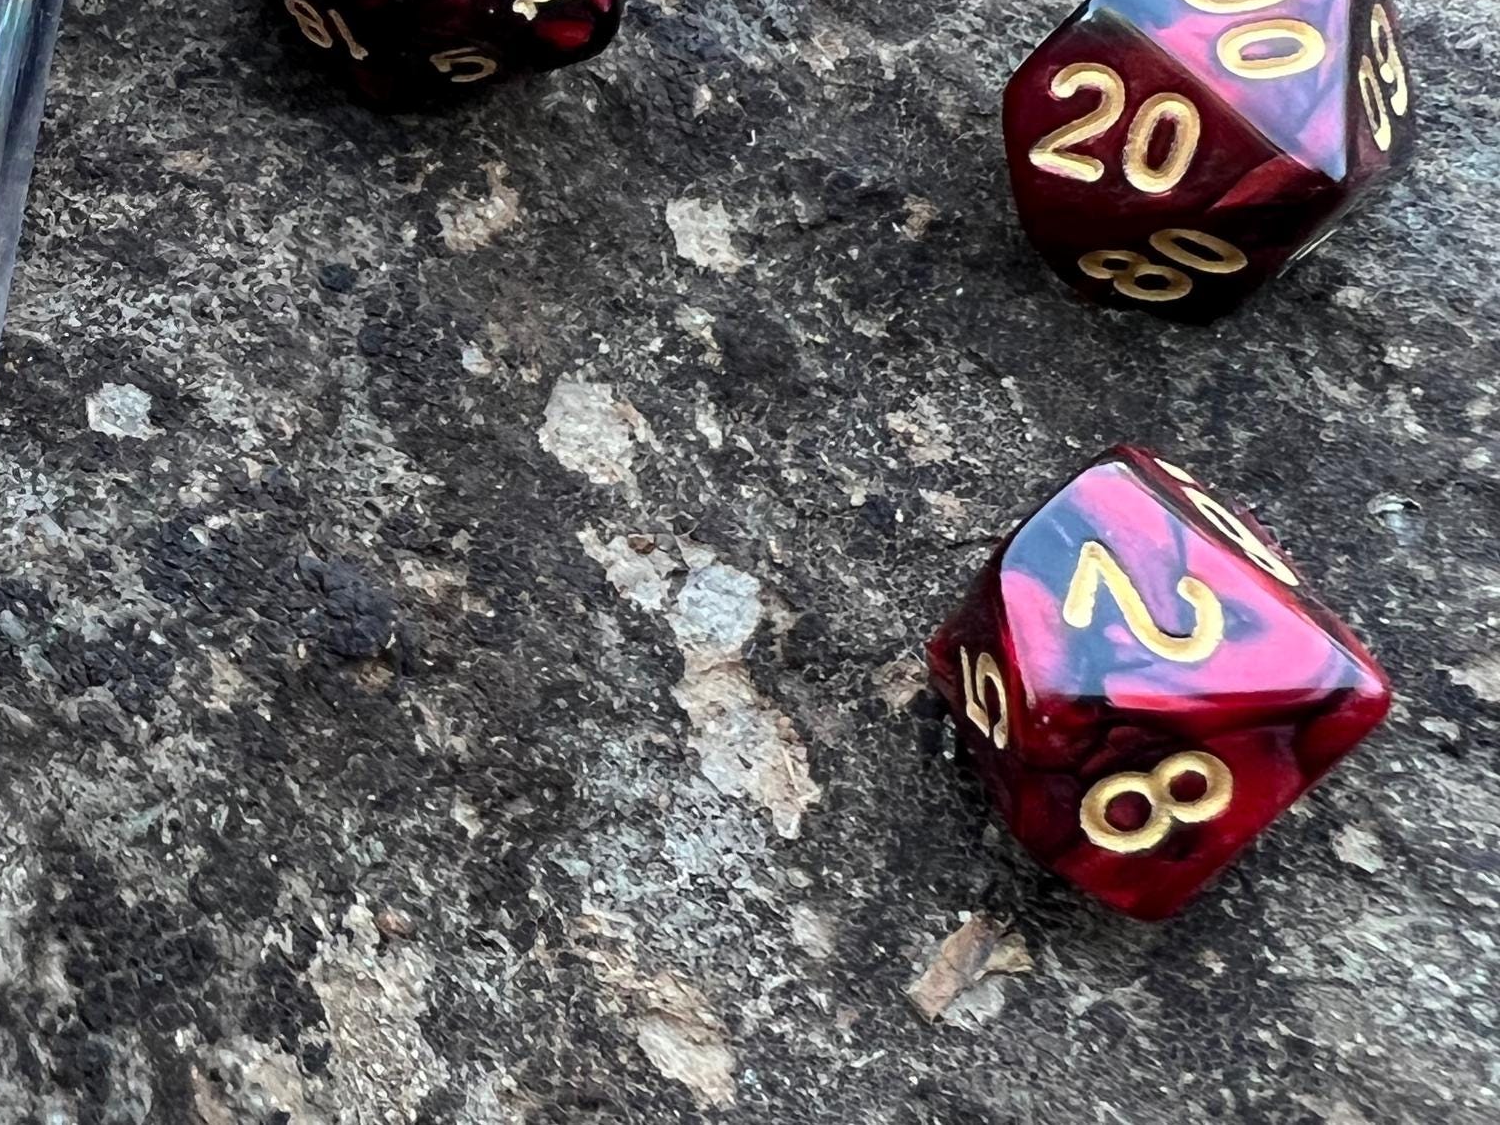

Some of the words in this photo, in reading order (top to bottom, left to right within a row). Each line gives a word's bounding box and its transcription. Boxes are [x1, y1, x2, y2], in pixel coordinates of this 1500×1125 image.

[1028, 61, 1201, 195] 20
[1077, 227, 1249, 302] 80
[1062, 540, 1225, 663] 2
[959, 645, 1009, 749] 5
[1079, 750, 1234, 854] 8
